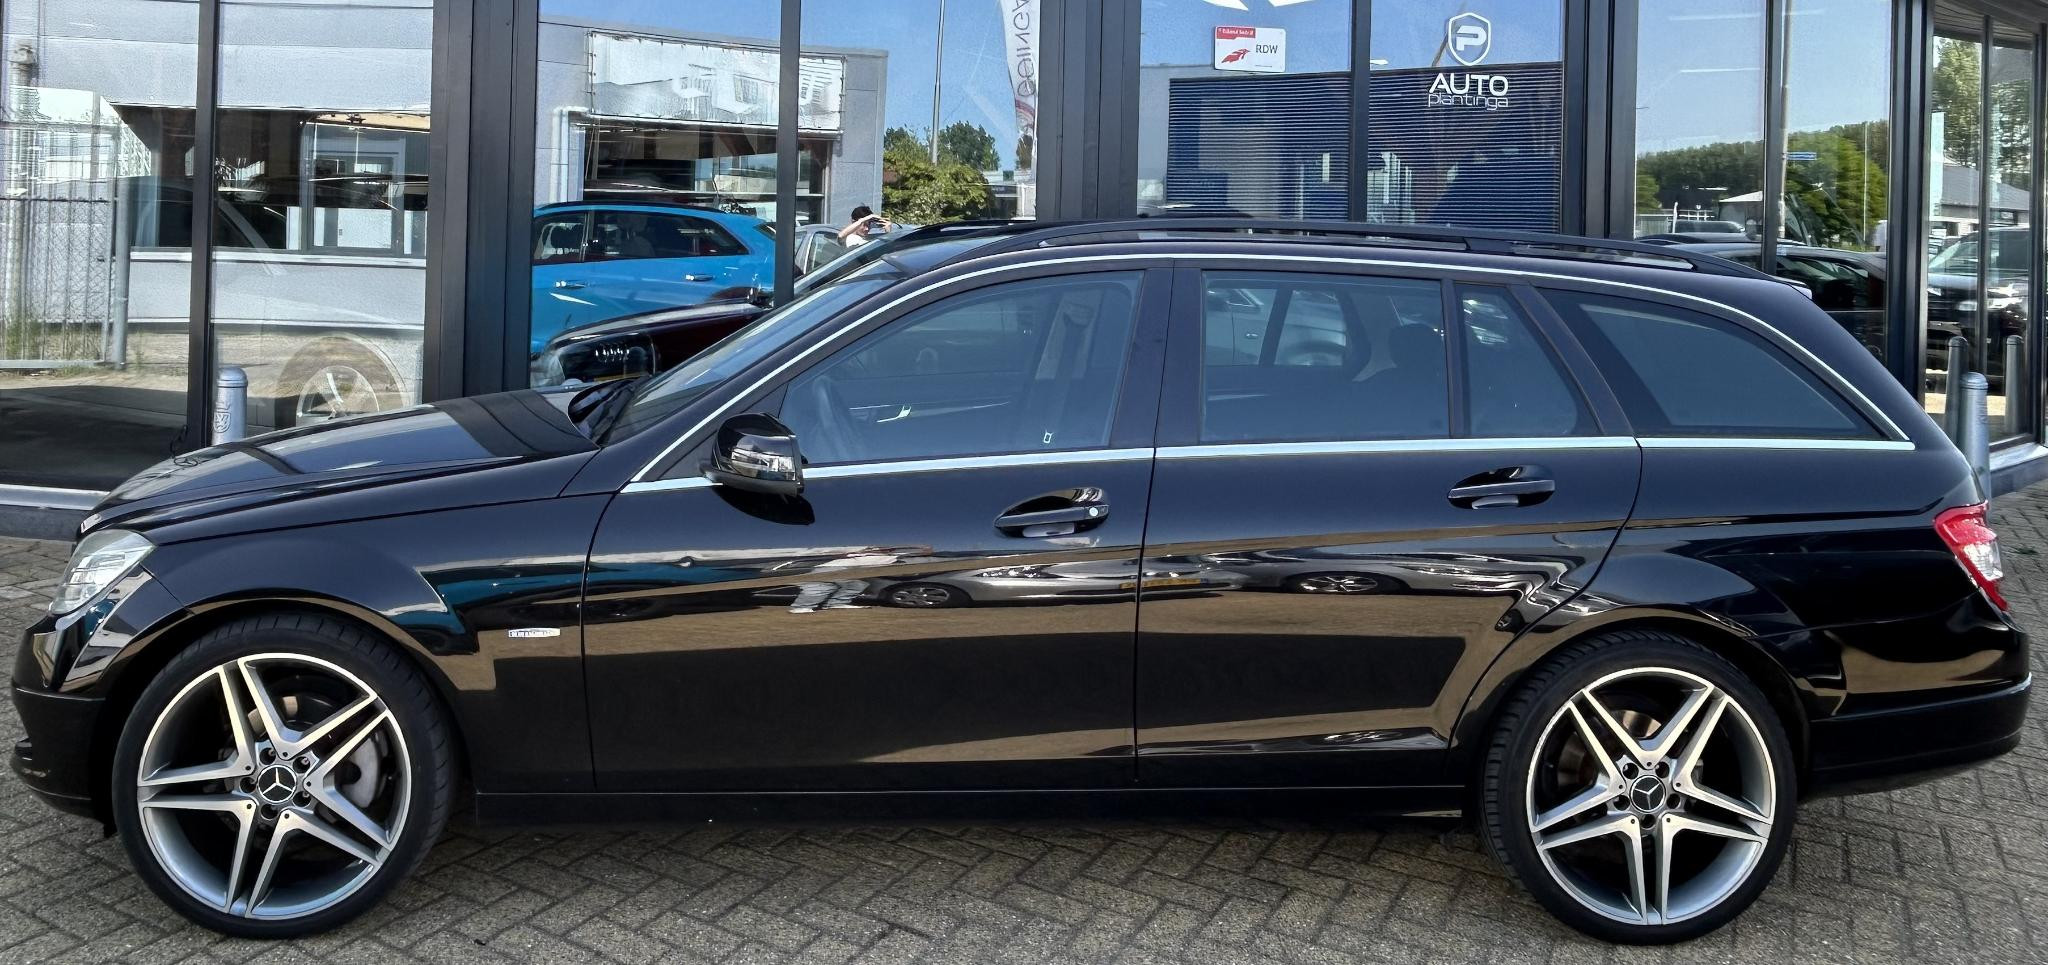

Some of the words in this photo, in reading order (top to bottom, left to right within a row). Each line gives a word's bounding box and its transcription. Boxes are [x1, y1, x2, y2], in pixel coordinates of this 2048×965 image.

[1456, 25, 1487, 51] P
[1255, 44, 1278, 54] RDW
[1428, 72, 1509, 96] AUTO
[1428, 92, 1509, 111] plantinga
